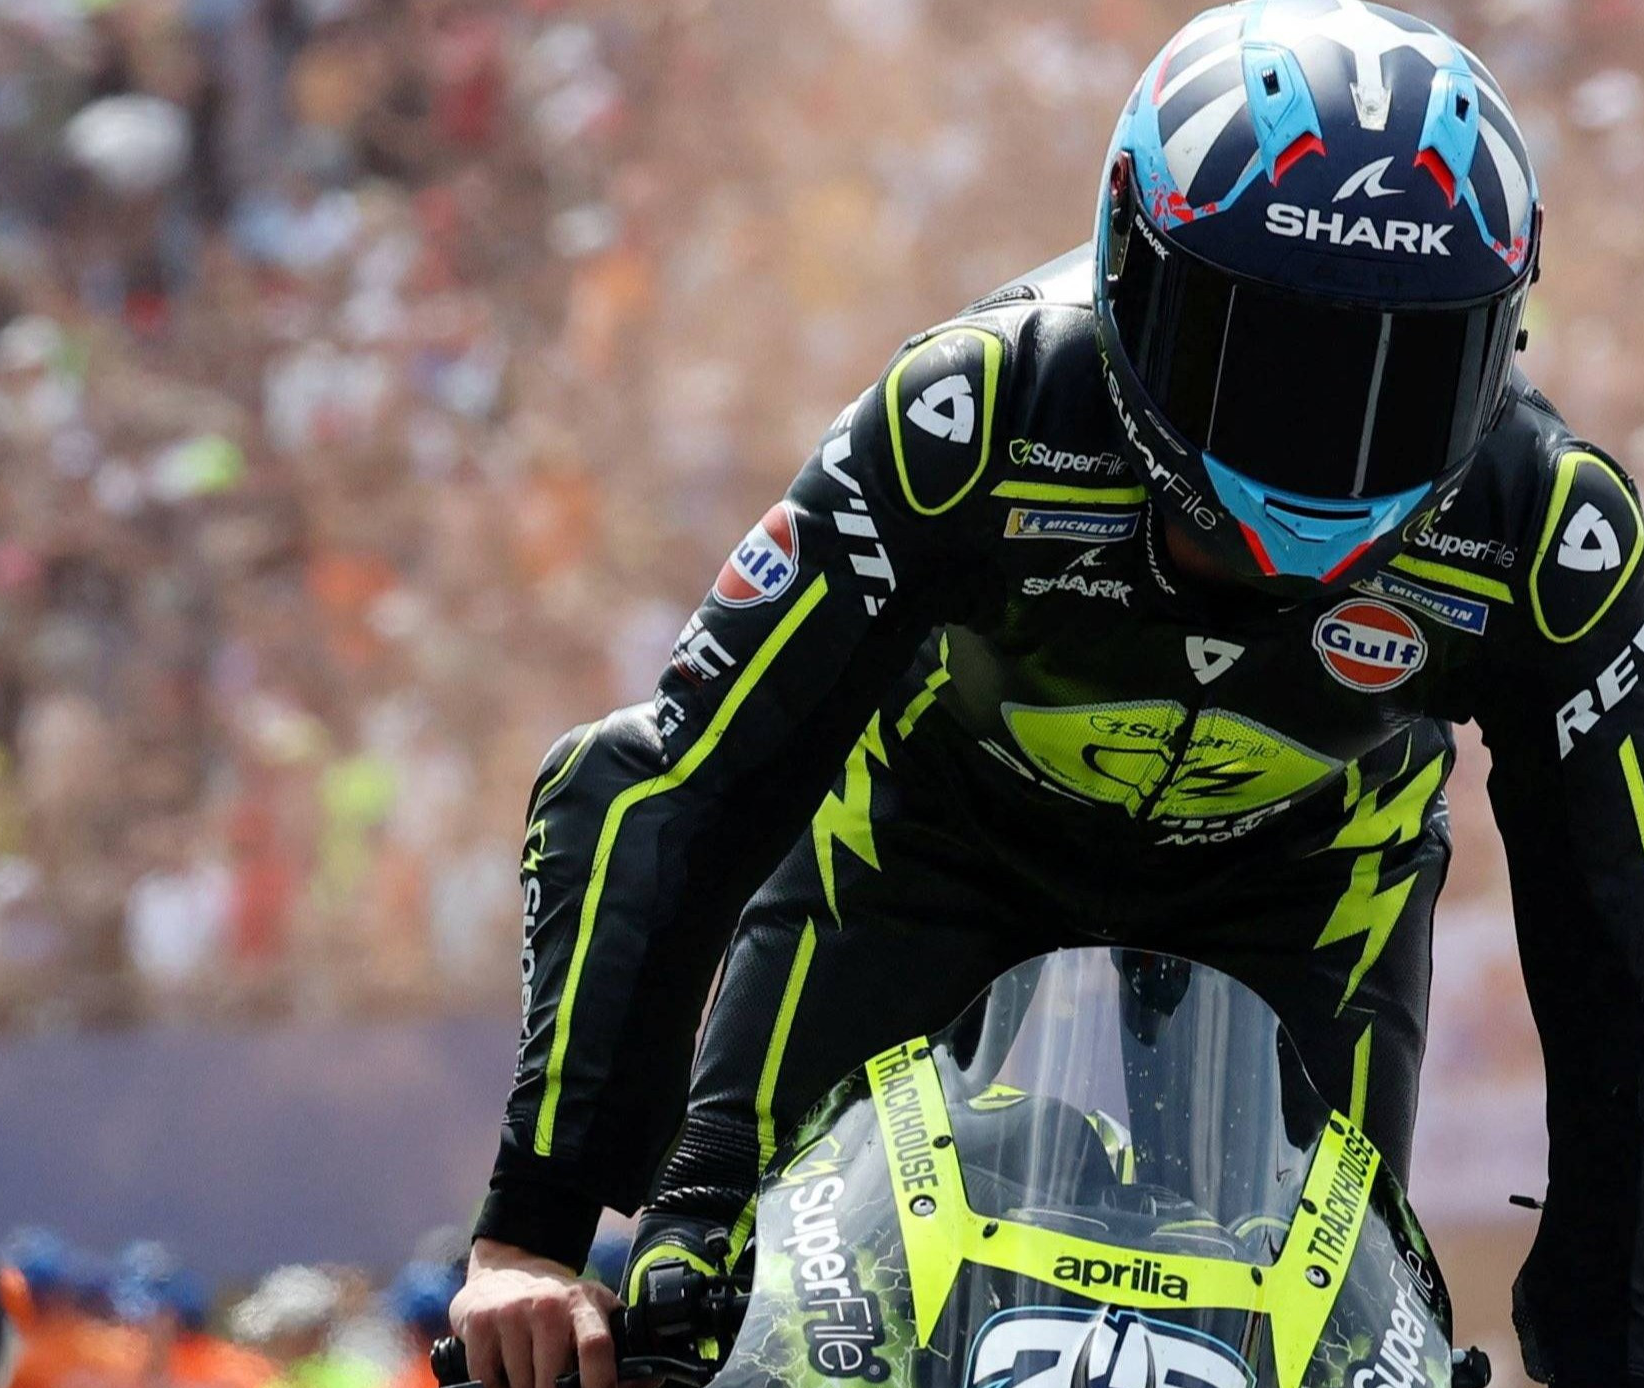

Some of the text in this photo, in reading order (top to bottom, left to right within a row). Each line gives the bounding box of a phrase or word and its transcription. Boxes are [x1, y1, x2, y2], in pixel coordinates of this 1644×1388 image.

[1135, 214, 1170, 261] SHARK
[1265, 203, 1454, 256] SHARK
[1044, 519, 1128, 534] MICHELIN
[1414, 524, 1516, 569] SuperFile
[736, 541, 789, 590] ulf
[1021, 574, 1134, 607] SHARK
[1388, 583, 1474, 622] MICHELIN
[1321, 622, 1419, 665] Gulf
[875, 1044, 939, 1192] TRACKHOUSE
[1306, 1126, 1376, 1266] TRACKHOUSE
[783, 1176, 875, 1371] SuperFile
[1054, 1256, 1189, 1301] aprilia
